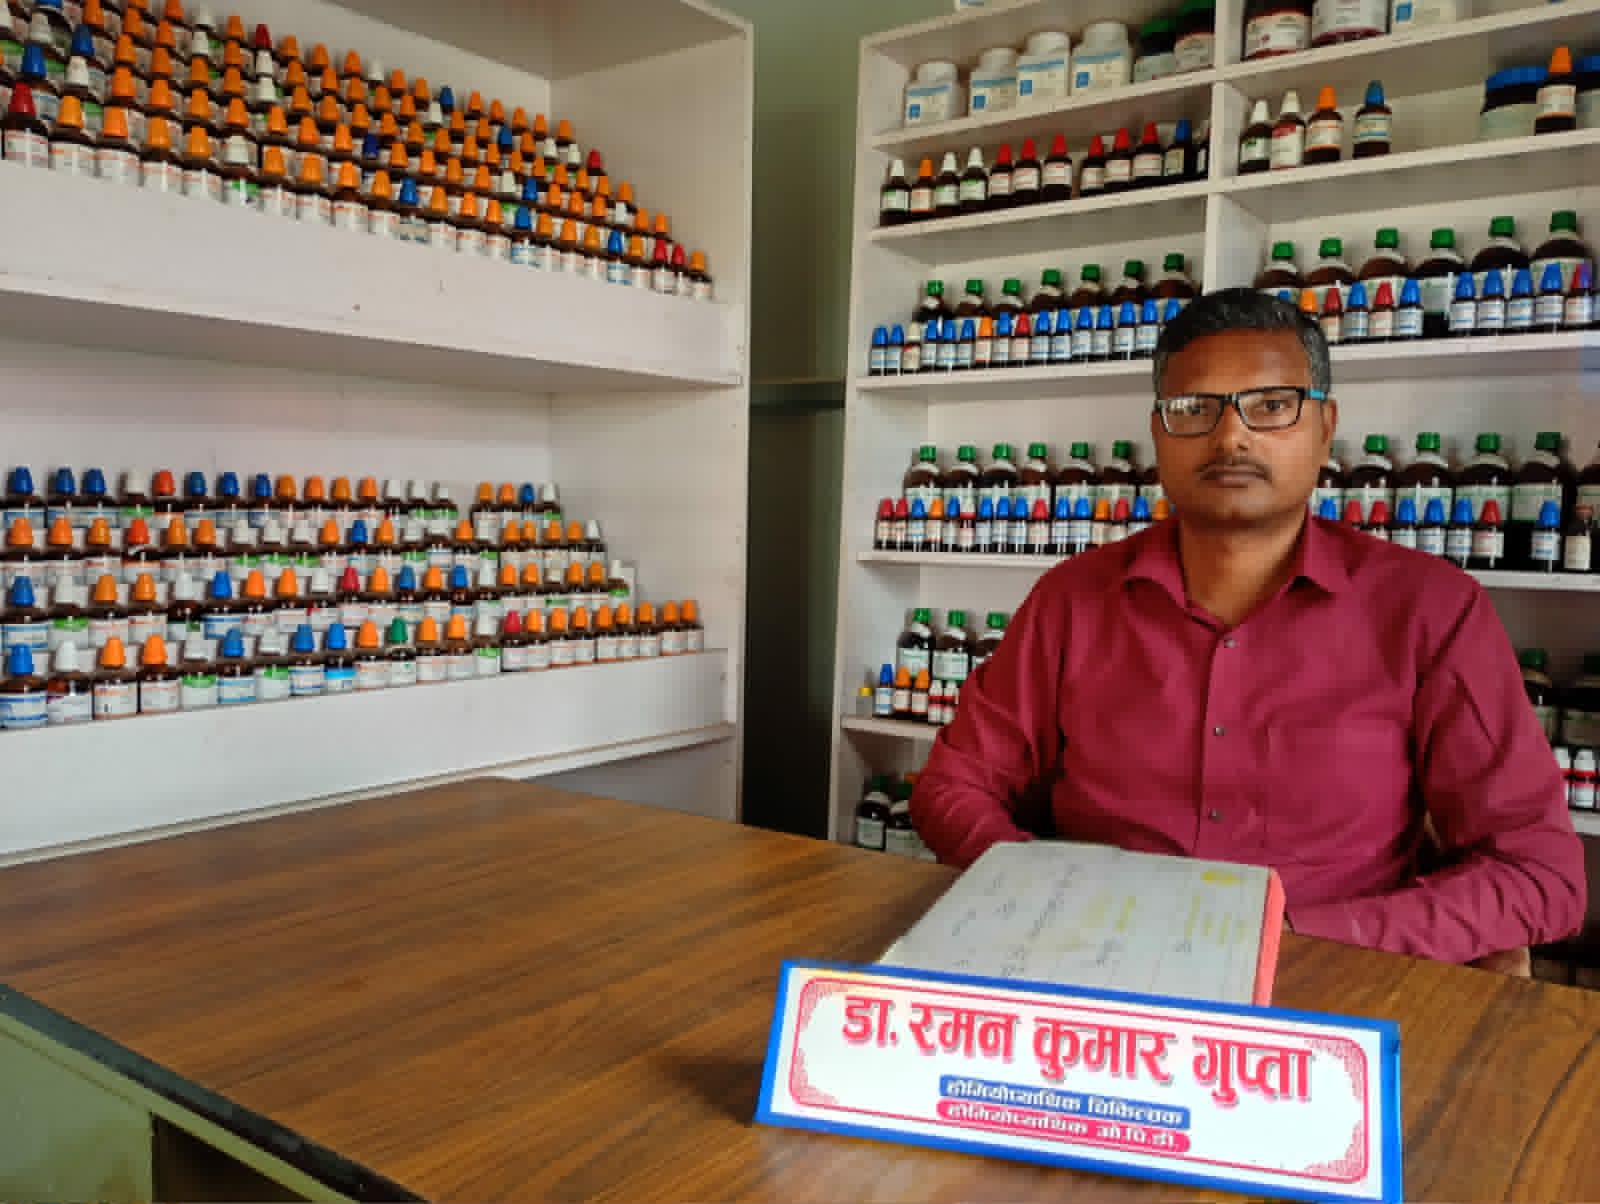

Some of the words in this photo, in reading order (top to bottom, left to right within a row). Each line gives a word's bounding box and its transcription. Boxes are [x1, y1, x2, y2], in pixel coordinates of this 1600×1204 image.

[842, 996, 898, 1047] डा.
[909, 1002, 1020, 1063] रमन
[1032, 1017, 1176, 1083] कुमार
[1192, 1036, 1313, 1107] गुप्ता
